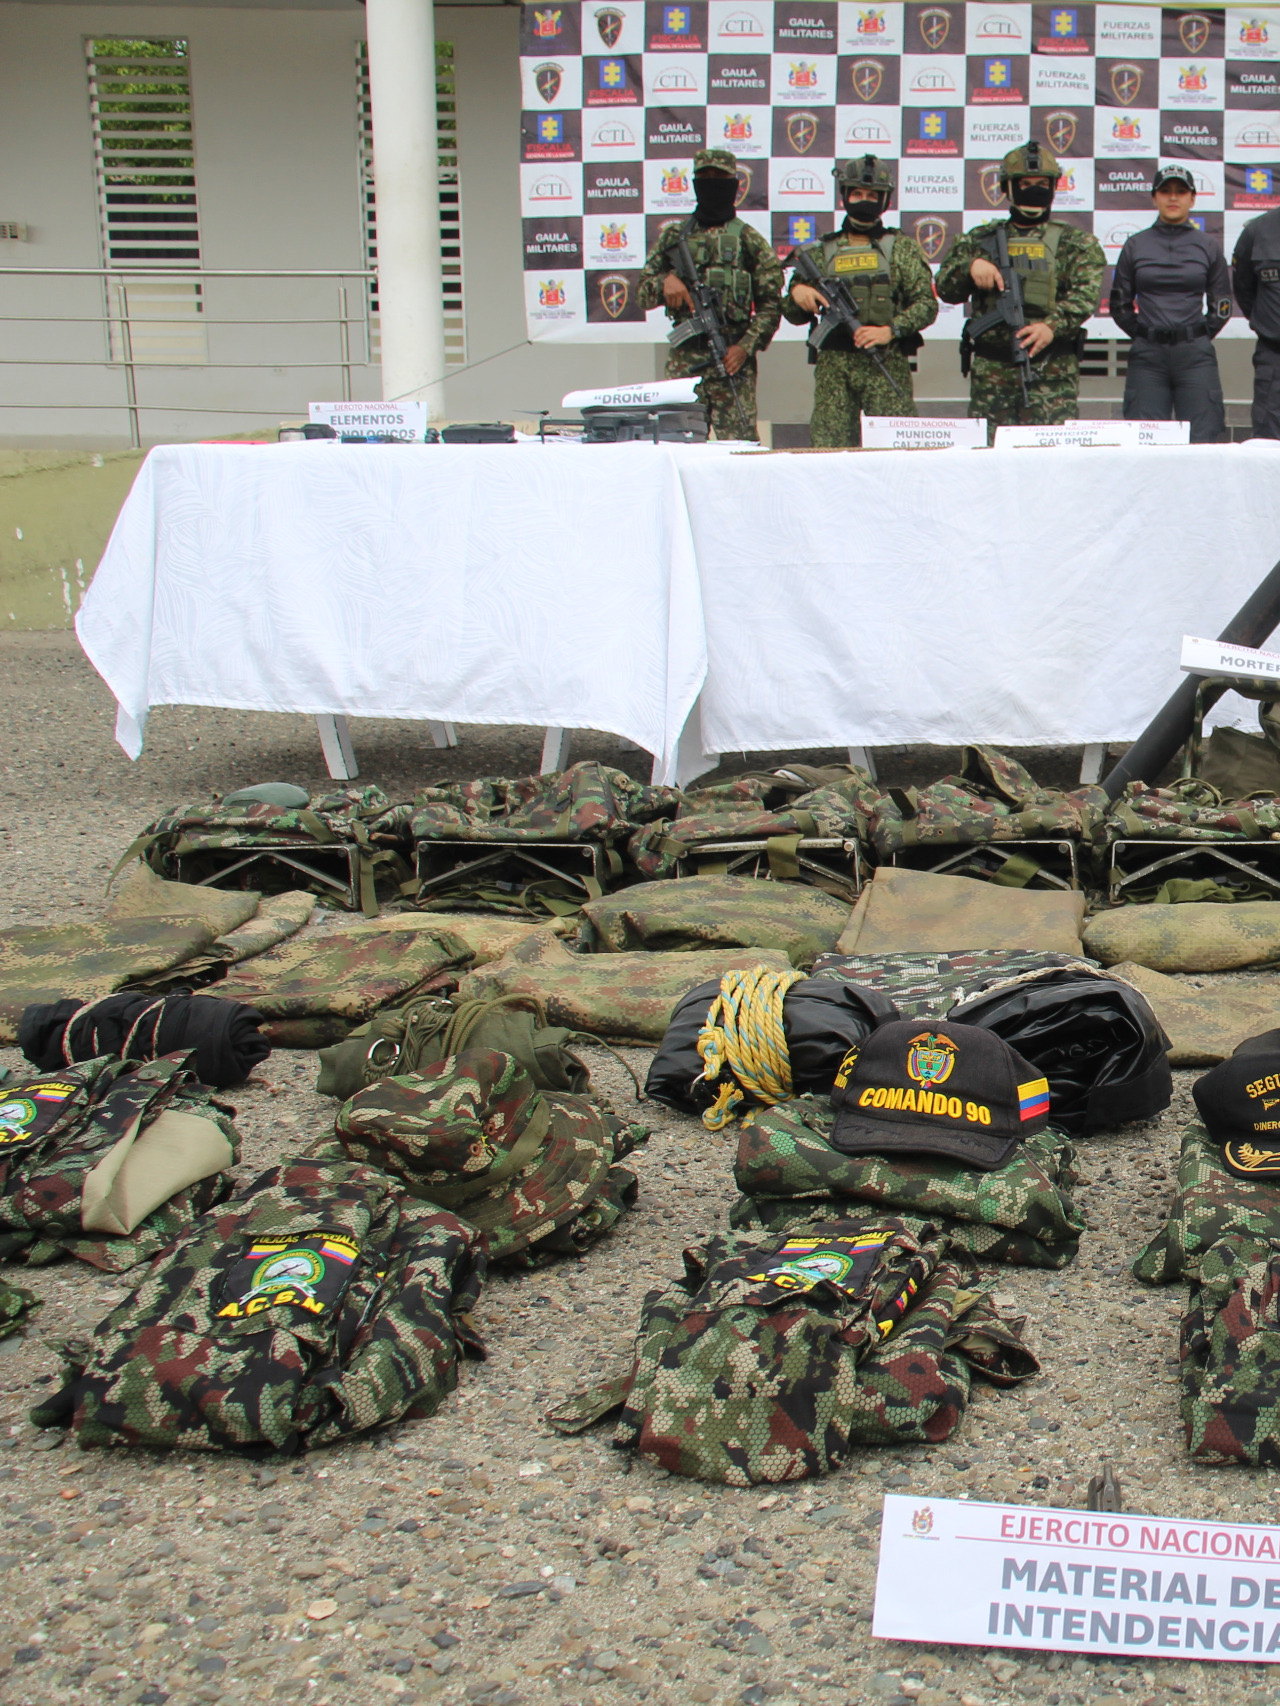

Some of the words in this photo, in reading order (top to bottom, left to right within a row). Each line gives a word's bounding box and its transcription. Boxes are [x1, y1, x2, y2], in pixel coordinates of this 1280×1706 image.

[725, 20, 753, 32] CTI
[789, 18, 824, 27] GAULA
[1103, 21, 1150, 30] FUERZAS
[983, 22, 1011, 34] CTI
[779, 28, 833, 39] MILITARES
[1101, 32, 1153, 40] MILITARES
[721, 68, 757, 77] GAULA
[1038, 70, 1086, 80] FUERZAS
[660, 75, 687, 87] CTI
[917, 75, 944, 87] CTI
[1241, 74, 1276, 83] GAULA
[712, 79, 765, 88] MILITARES
[1036, 81, 1089, 90] MILITARES
[659, 123, 693, 132] GAULA
[973, 123, 1020, 131] FUERZAS
[1173, 125, 1209, 134] GAULA
[598, 129, 625, 142] CTI
[852, 127, 880, 139] CTI
[1242, 131, 1270, 143] CTI
[650, 134, 701, 143] MILITARES
[970, 134, 1023, 142] MILITARES
[1163, 135, 1217, 145] MILITARES
[907, 175, 954, 183] FUERZAS
[1109, 172, 1144, 181] GAULA
[596, 177, 630, 187] GAULA
[786, 177, 813, 190] CTI
[536, 183, 562, 195] CTI
[905, 186, 958, 194] MILITARES
[1099, 183, 1152, 192] MILITARES
[587, 188, 638, 198] MILITARES
[535, 233, 569, 242] GAULA
[526, 244, 577, 253] MILITARES
[330, 414, 404, 425] ELEMENTOS
[336, 429, 416, 440] CNOLOGICOS
[896, 430, 951, 439] MUNICION
[1065, 437, 1092, 445] 9MM
[858, 1087, 963, 1119] COMANDO
[965, 1101, 992, 1125] 90
[252, 1235, 299, 1244] FUERZAS
[1000, 1513, 1130, 1548] EJERCITO
[1001, 1557, 1217, 1606] MATERIAL
